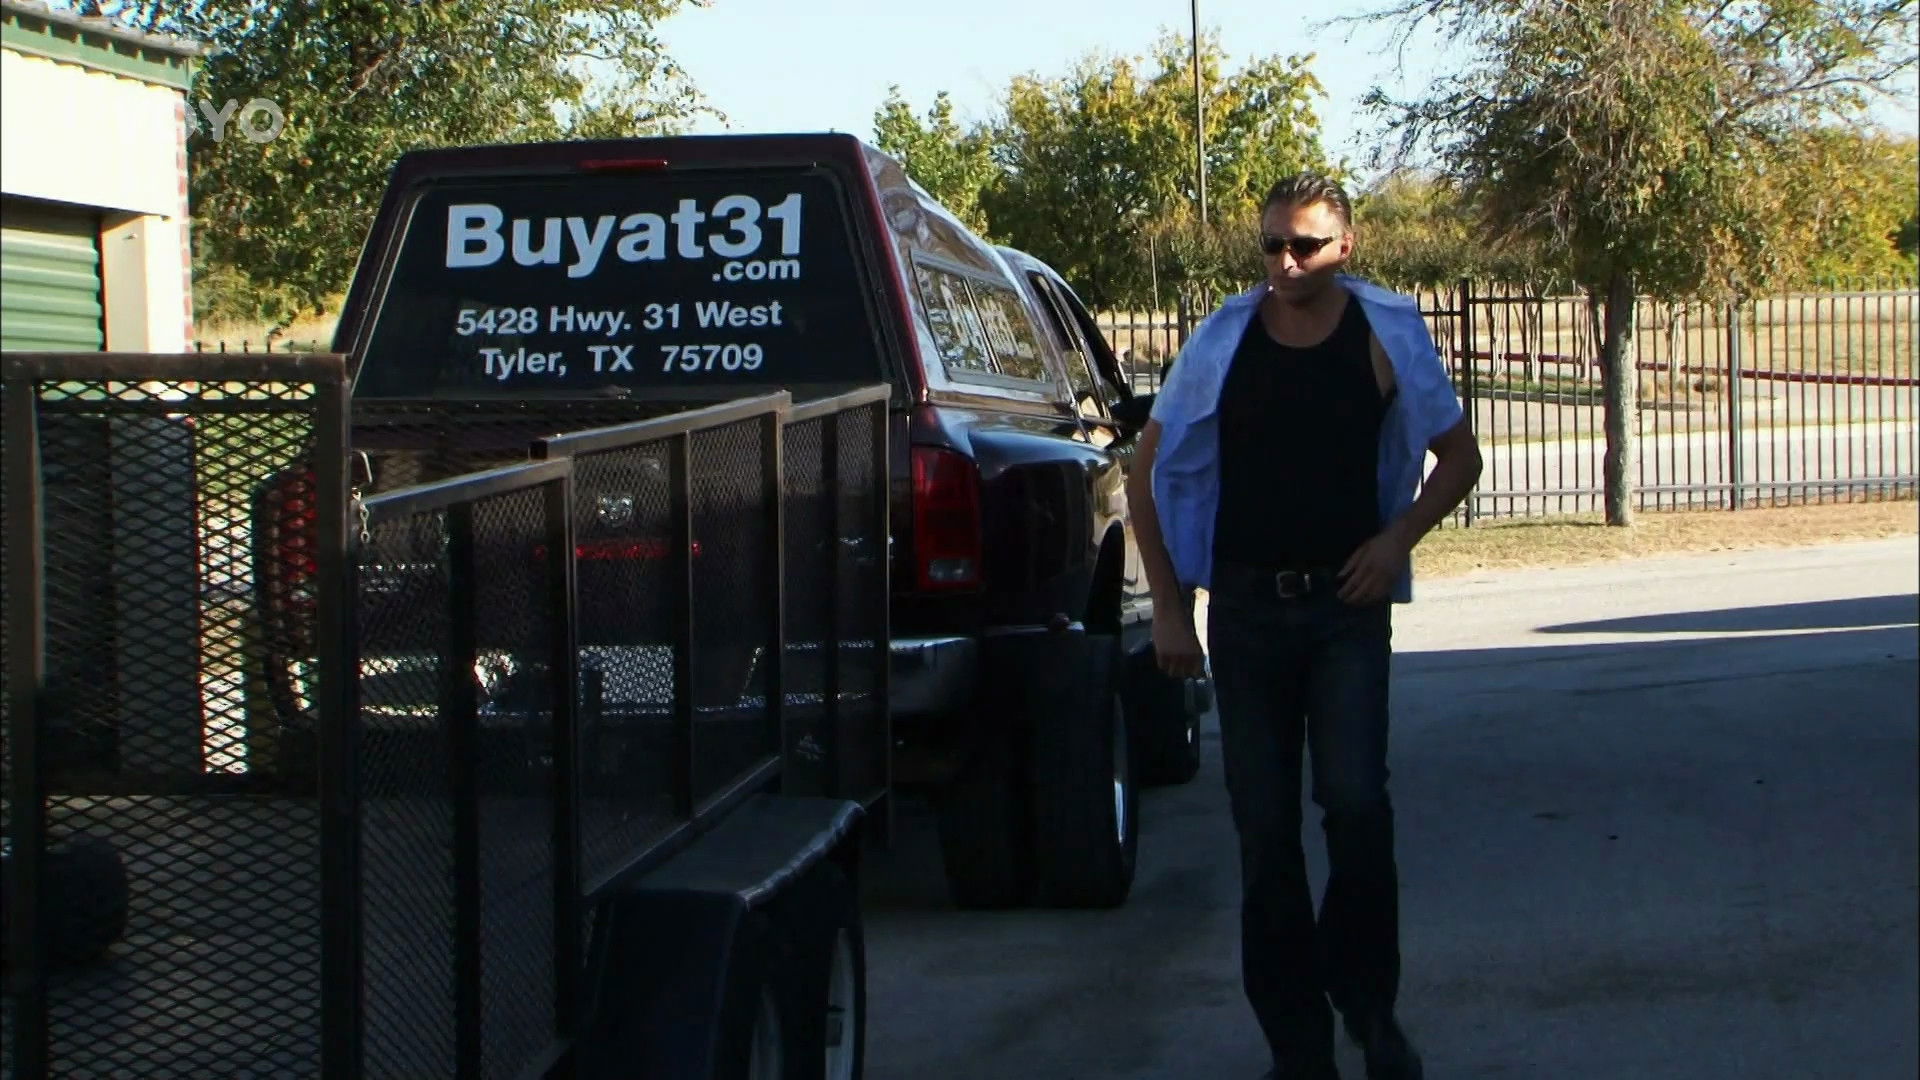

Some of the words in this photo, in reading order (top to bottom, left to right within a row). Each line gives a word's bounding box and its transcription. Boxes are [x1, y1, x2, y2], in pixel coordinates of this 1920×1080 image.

[446, 193, 802, 279] Buyat31
[712, 257, 800, 282] .com
[456, 307, 538, 336] 5428
[549, 305, 631, 337] Hwy.
[643, 303, 680, 330] 31
[696, 300, 783, 329] West
[479, 347, 567, 380] Tyler,
[587, 345, 634, 373] TX
[660, 344, 764, 372] 75709
